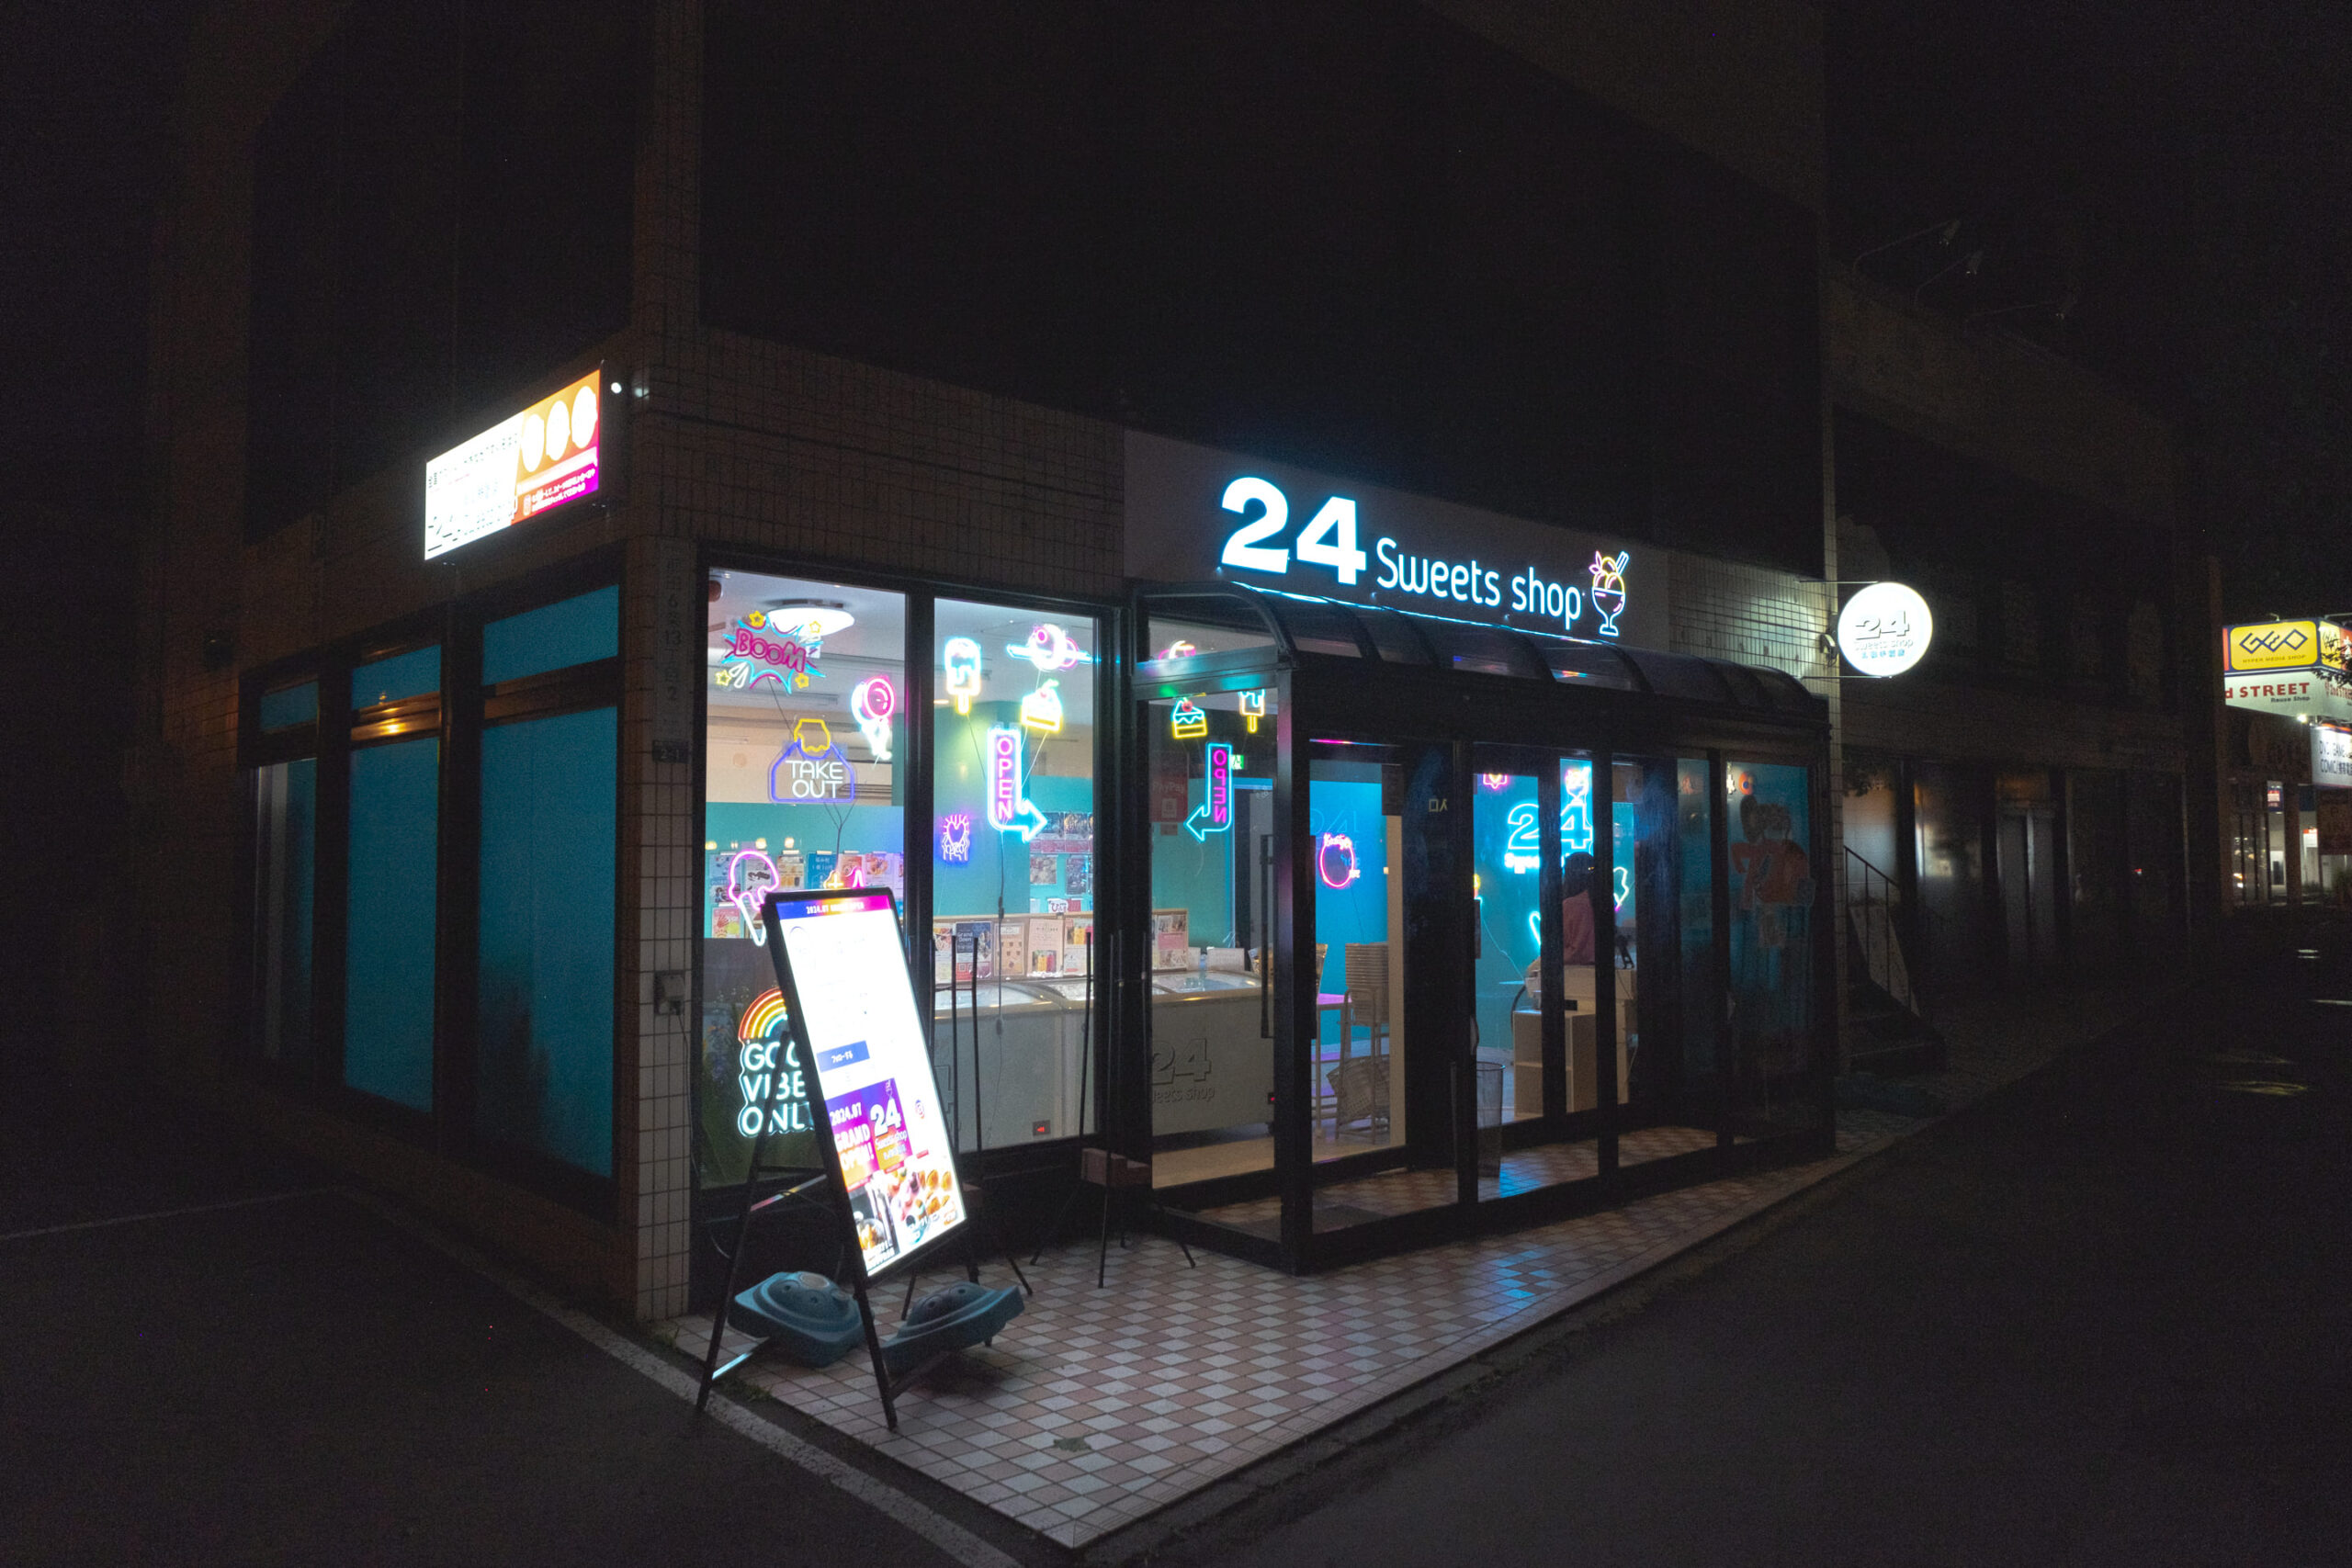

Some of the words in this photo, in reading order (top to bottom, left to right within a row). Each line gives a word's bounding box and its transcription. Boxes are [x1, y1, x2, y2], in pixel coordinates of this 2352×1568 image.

[1221, 476, 1367, 585] 24
[1376, 537, 1501, 607] Sweets
[1511, 566, 1582, 630] shop
[1854, 611, 1910, 640] 24
[735, 627, 807, 673] BOOM
[2239, 629, 2308, 654] GEO
[2239, 682, 2310, 698] STREET
[786, 760, 843, 780] TAKE
[996, 736, 1013, 820] OPEN
[792, 780, 843, 799] OUT
[744, 1041, 800, 1071] GOO
[743, 1070, 807, 1102] VIBE
[741, 1102, 806, 1135] ONL
[829, 1101, 863, 1126] 2024.07
[870, 1097, 902, 1138] 24
[834, 1122, 871, 1152] GRAND
